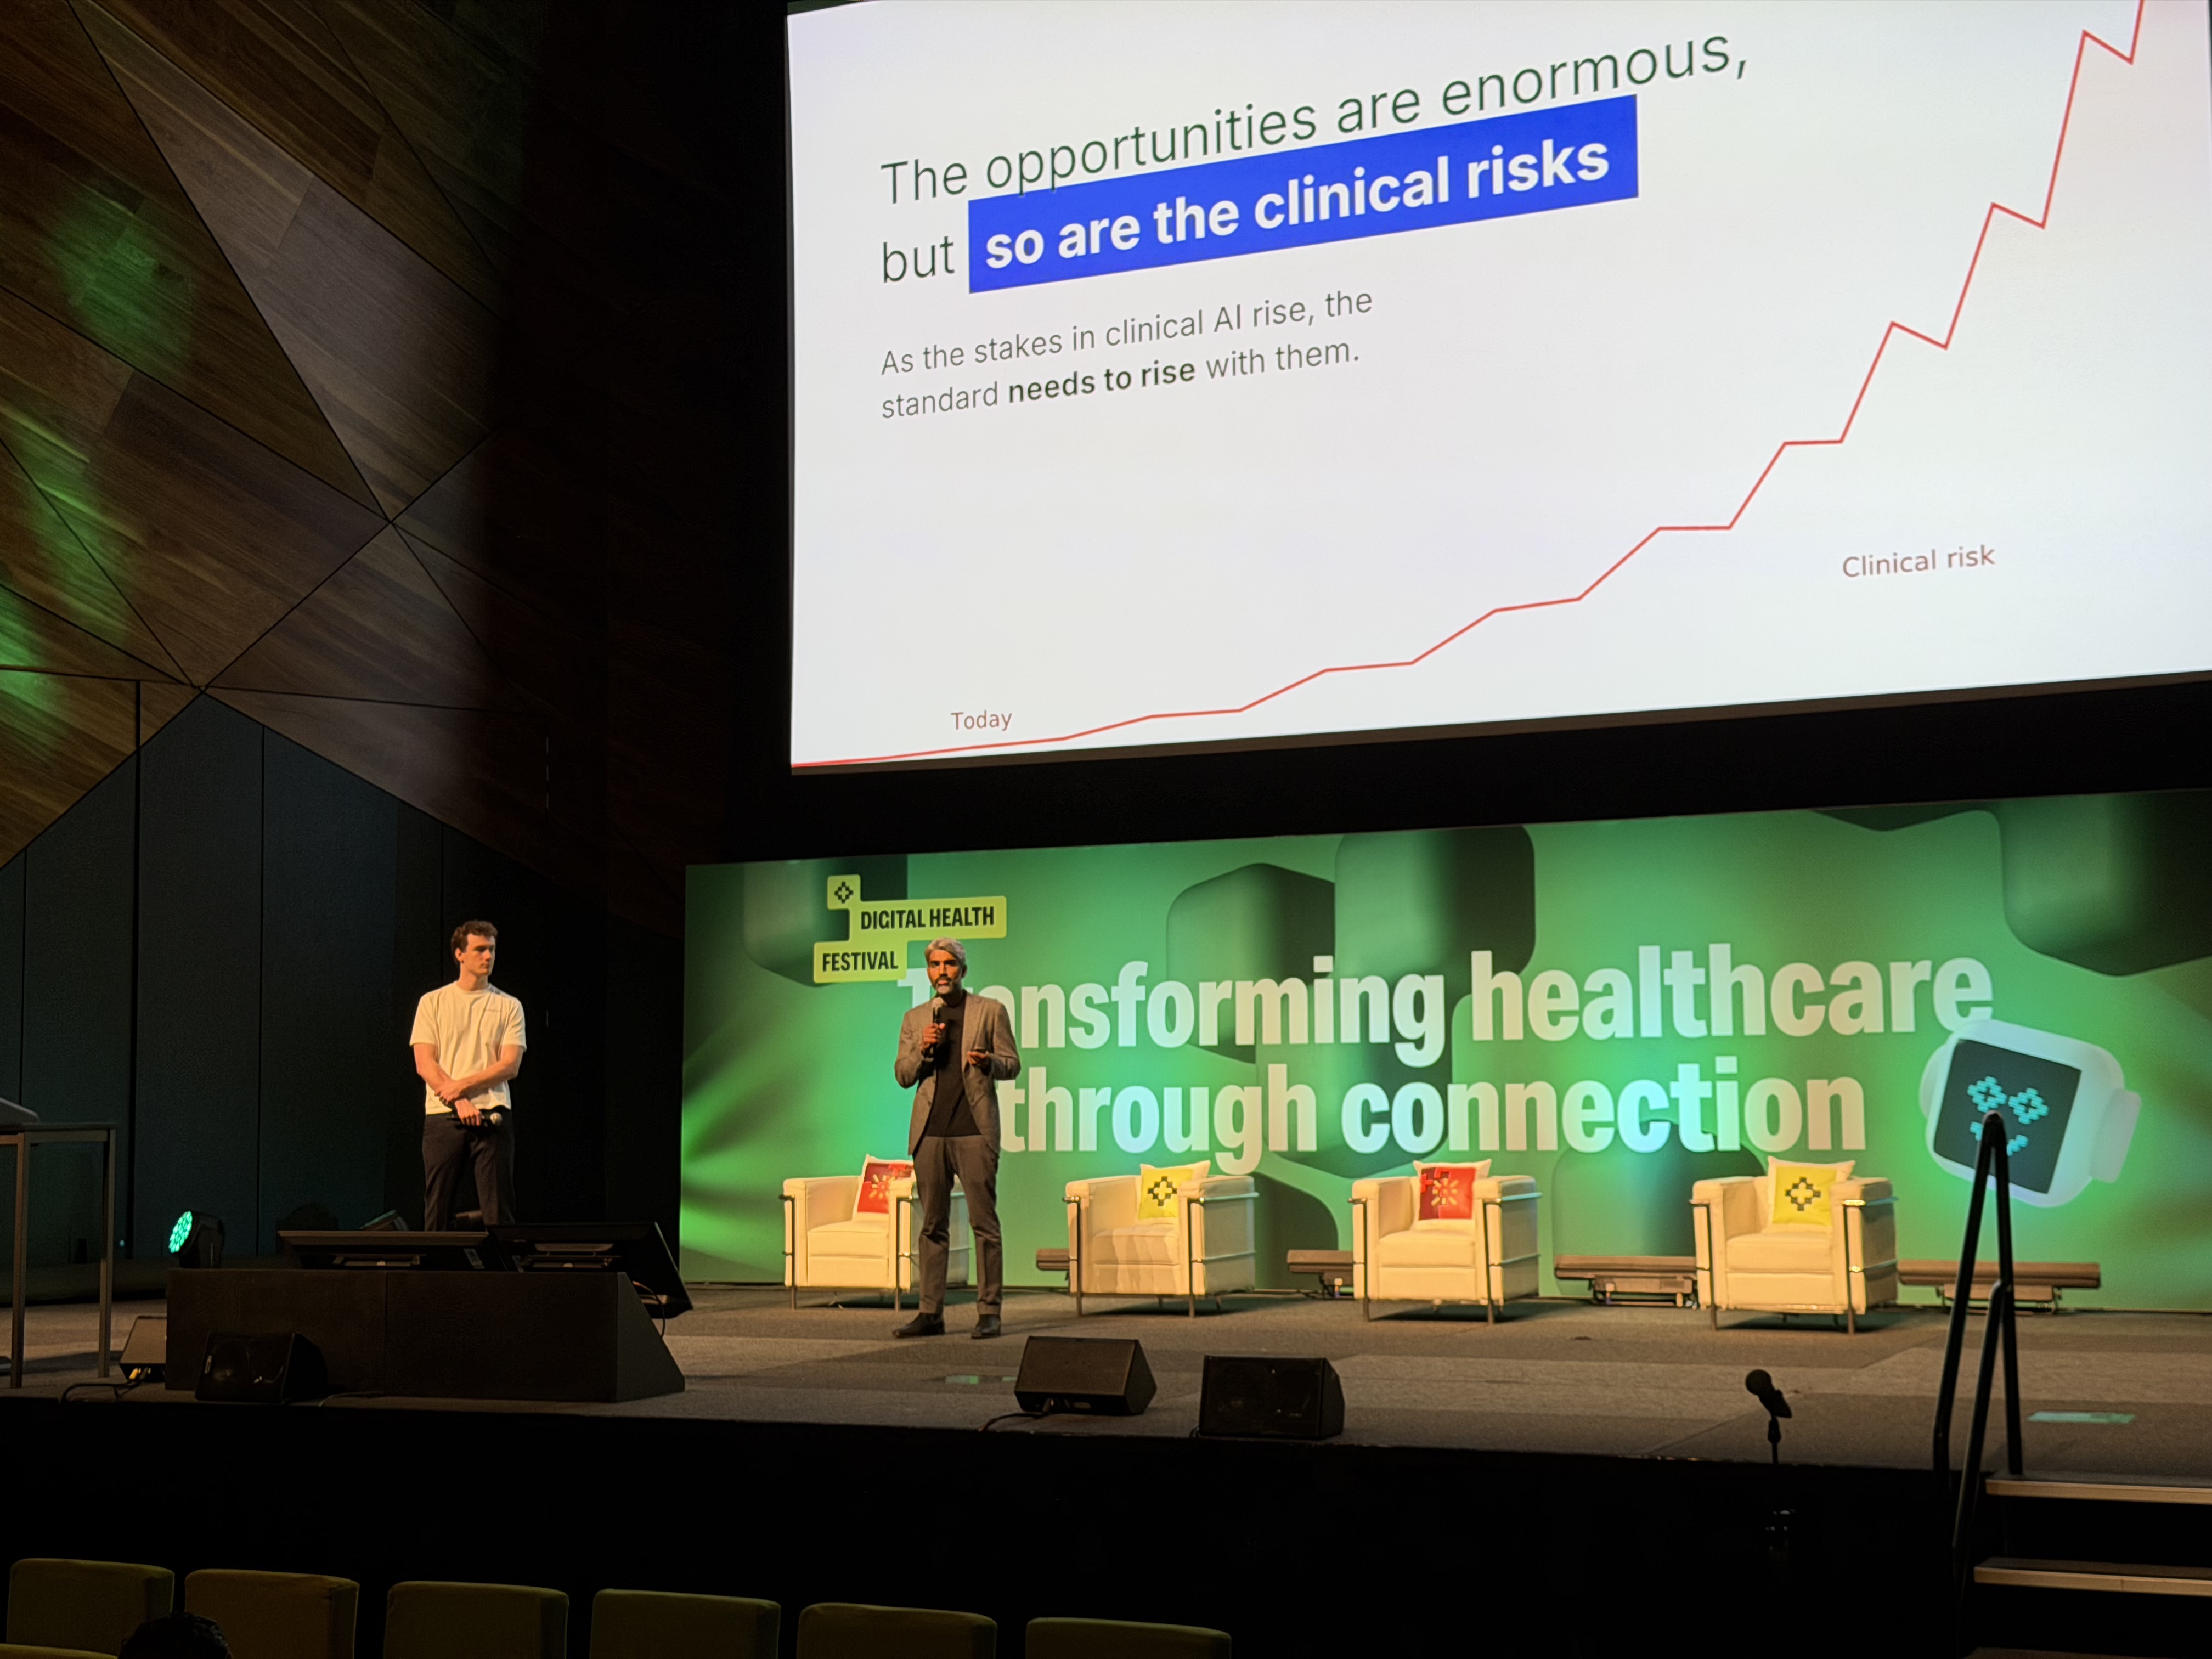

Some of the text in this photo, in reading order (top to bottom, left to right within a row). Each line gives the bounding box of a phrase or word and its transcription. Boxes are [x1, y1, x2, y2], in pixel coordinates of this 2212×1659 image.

[881, 35, 1747, 205] The opportunities are enormous,
[882, 138, 1609, 284] but so are the clinical risks
[881, 290, 1373, 376] As the stakes in clinical AI rise, the
[882, 342, 1359, 419] standard needs to rise with them.
[1842, 543, 1996, 579] Clinical risk
[950, 709, 1013, 732] Today
[861, 906, 995, 930] DIGITAL HEALTH
[822, 950, 899, 972] FESTIVAL
[1470, 943, 1994, 1041] healthcare
[996, 1056, 1866, 1175] through connection
